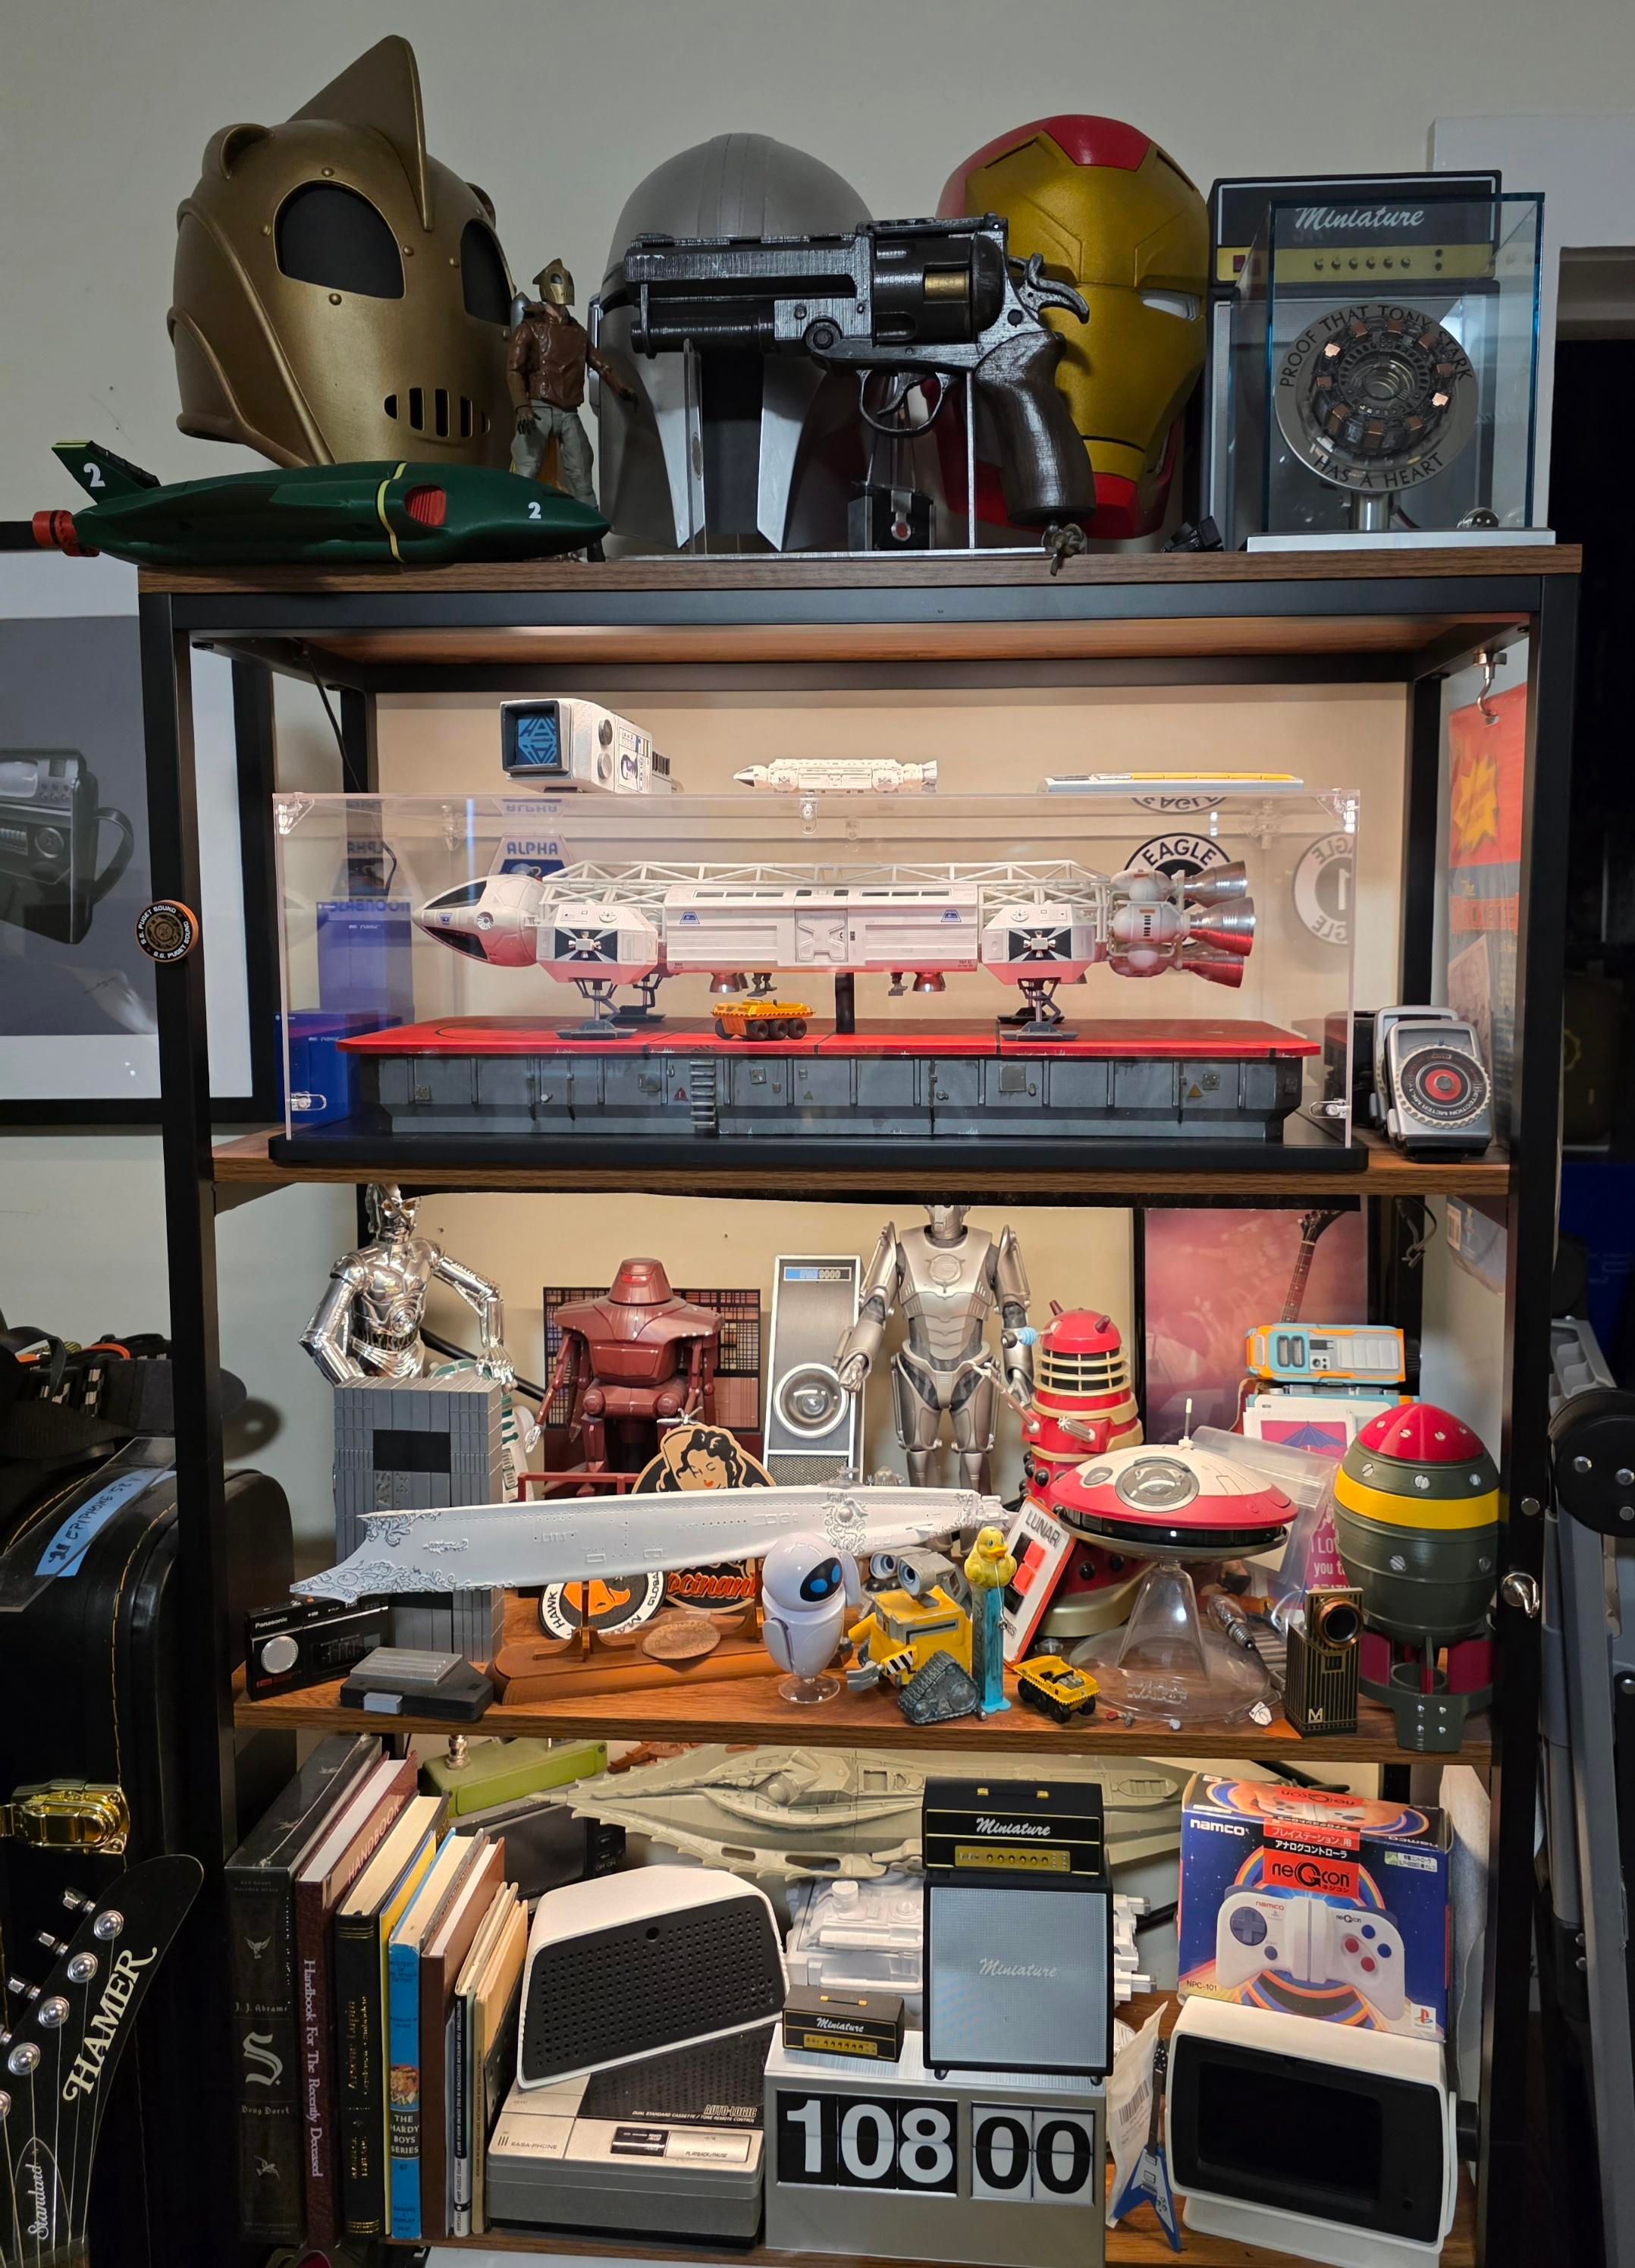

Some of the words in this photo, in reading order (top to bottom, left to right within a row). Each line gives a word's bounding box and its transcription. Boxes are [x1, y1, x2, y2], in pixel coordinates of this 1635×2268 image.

[1295, 206, 1425, 231] Miniature
[1280, 330, 1316, 387] PROOF
[1319, 306, 1368, 332] THAT
[1377, 305, 1433, 326] TONY
[1439, 331, 1473, 381] STARK
[83, 463, 105, 487] 2
[1313, 455, 1351, 482] HAS
[1360, 476, 1372, 488] A
[1385, 452, 1443, 488] HEART
[528, 501, 541, 519] 2
[507, 841, 558, 856] ALPHA
[1141, 839, 1216, 865] EAGLE
[138, 909, 152, 929] PUGET
[153, 905, 177, 913] SOUND
[168, 944, 186, 958] PUGET
[1421, 1103, 1448, 1117] METER
[819, 1269, 840, 1279] 9000
[66, 1494, 113, 1540] EPIPHONE
[1025, 1509, 1060, 1547] LUNAR
[1313, 1563, 1333, 1578] you
[547, 1591, 566, 1629] HAWK
[255, 1616, 288, 1629] Panasonic
[976, 1817, 1050, 1836] Miniature
[1190, 1818, 1245, 1836] namco
[348, 1795, 400, 1884] HANDBOOK
[1275, 1839, 1348, 1858] アナログコントローラ
[1256, 1901, 1285, 1911] namco
[979, 1958, 1057, 1978] Miniature
[304, 1959, 317, 2021] Handbook
[1186, 1980, 1217, 1991] NPC-101
[255, 2003, 288, 2012] Abrams
[63, 1947, 157, 2100] HAMER
[817, 2017, 865, 2033] Miniature
[306, 2027, 318, 2046] For
[308, 2050, 319, 2073] The
[306, 2078, 321, 2122] Recently
[242, 2105, 262, 2116] Doug
[394, 2114, 413, 2123] THE
[704, 2104, 757, 2119] AUTO-LOGIC
[394, 2135, 416, 2144] BOYS
[511, 2141, 558, 2150] EASA-PHONE
[786, 2099, 953, 2184] 108
[976, 2116, 1091, 2194] 00
[310, 2127, 324, 2176] Deceased
[391, 2145, 419, 2154] SERIES
[25, 2163, 49, 2240] Standard
